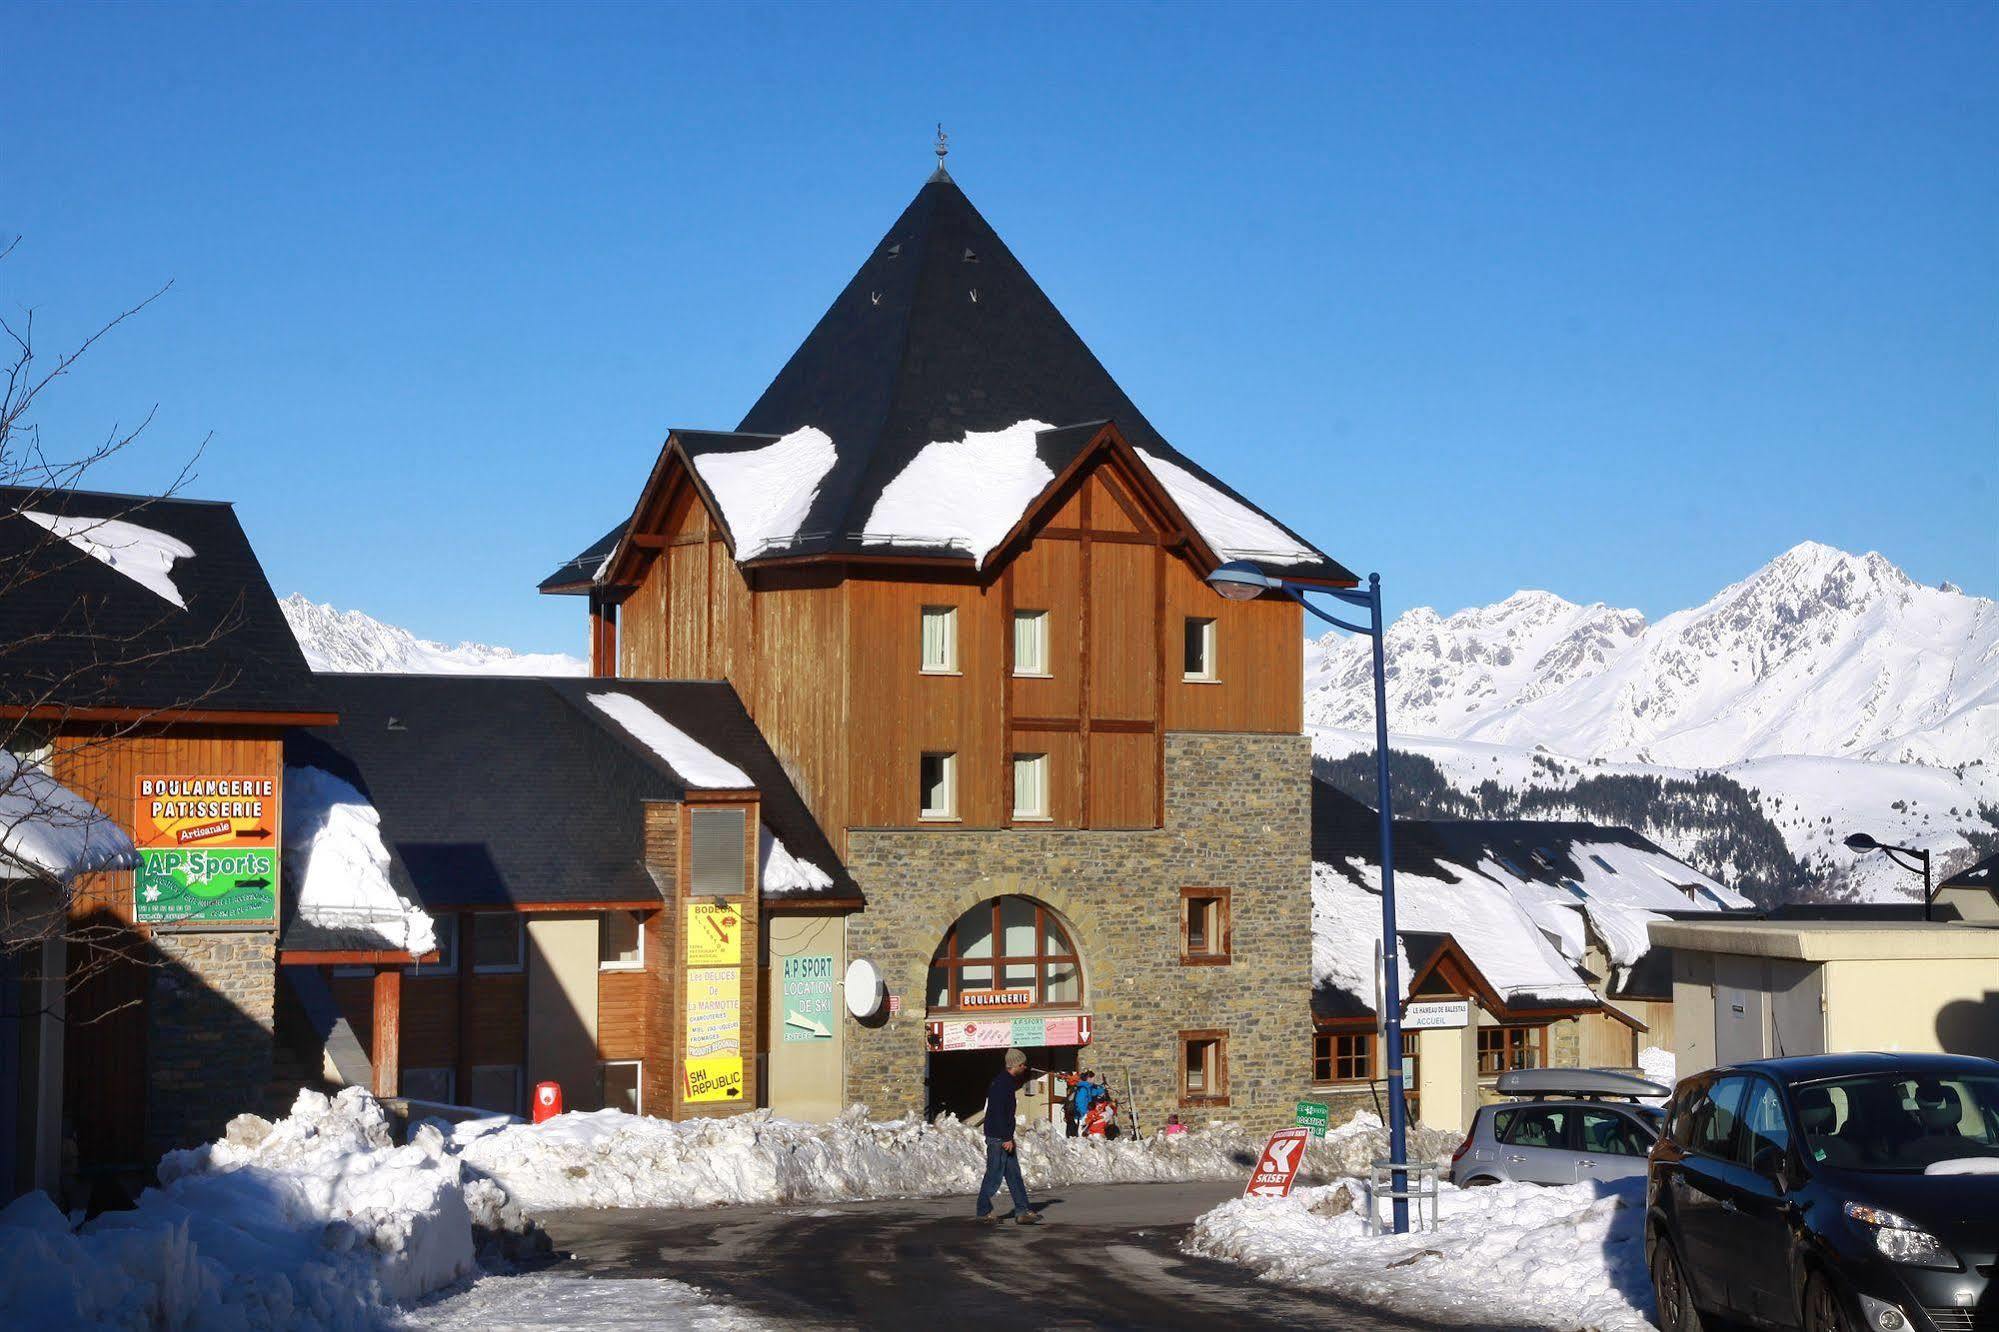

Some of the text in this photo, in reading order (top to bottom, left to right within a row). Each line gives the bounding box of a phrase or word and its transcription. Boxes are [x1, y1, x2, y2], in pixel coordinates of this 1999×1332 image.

[142, 780, 272, 796] BOULANGERIE
[152, 801, 262, 817] PATISSERIE
[180, 822, 230, 841] Artisanale
[145, 852, 270, 881] AP Sports
[802, 957, 832, 978] SPORT
[784, 981, 832, 996] LOCATION
[698, 1000, 739, 1010] MARMOTTE
[800, 999, 831, 1013] DE SKI
[964, 993, 1028, 1006] BOULANGERIE
[1417, 1017, 1446, 1025] ACCUEIL
[690, 1069, 707, 1084] SKI
[1256, 1174, 1289, 1183] SKISET
